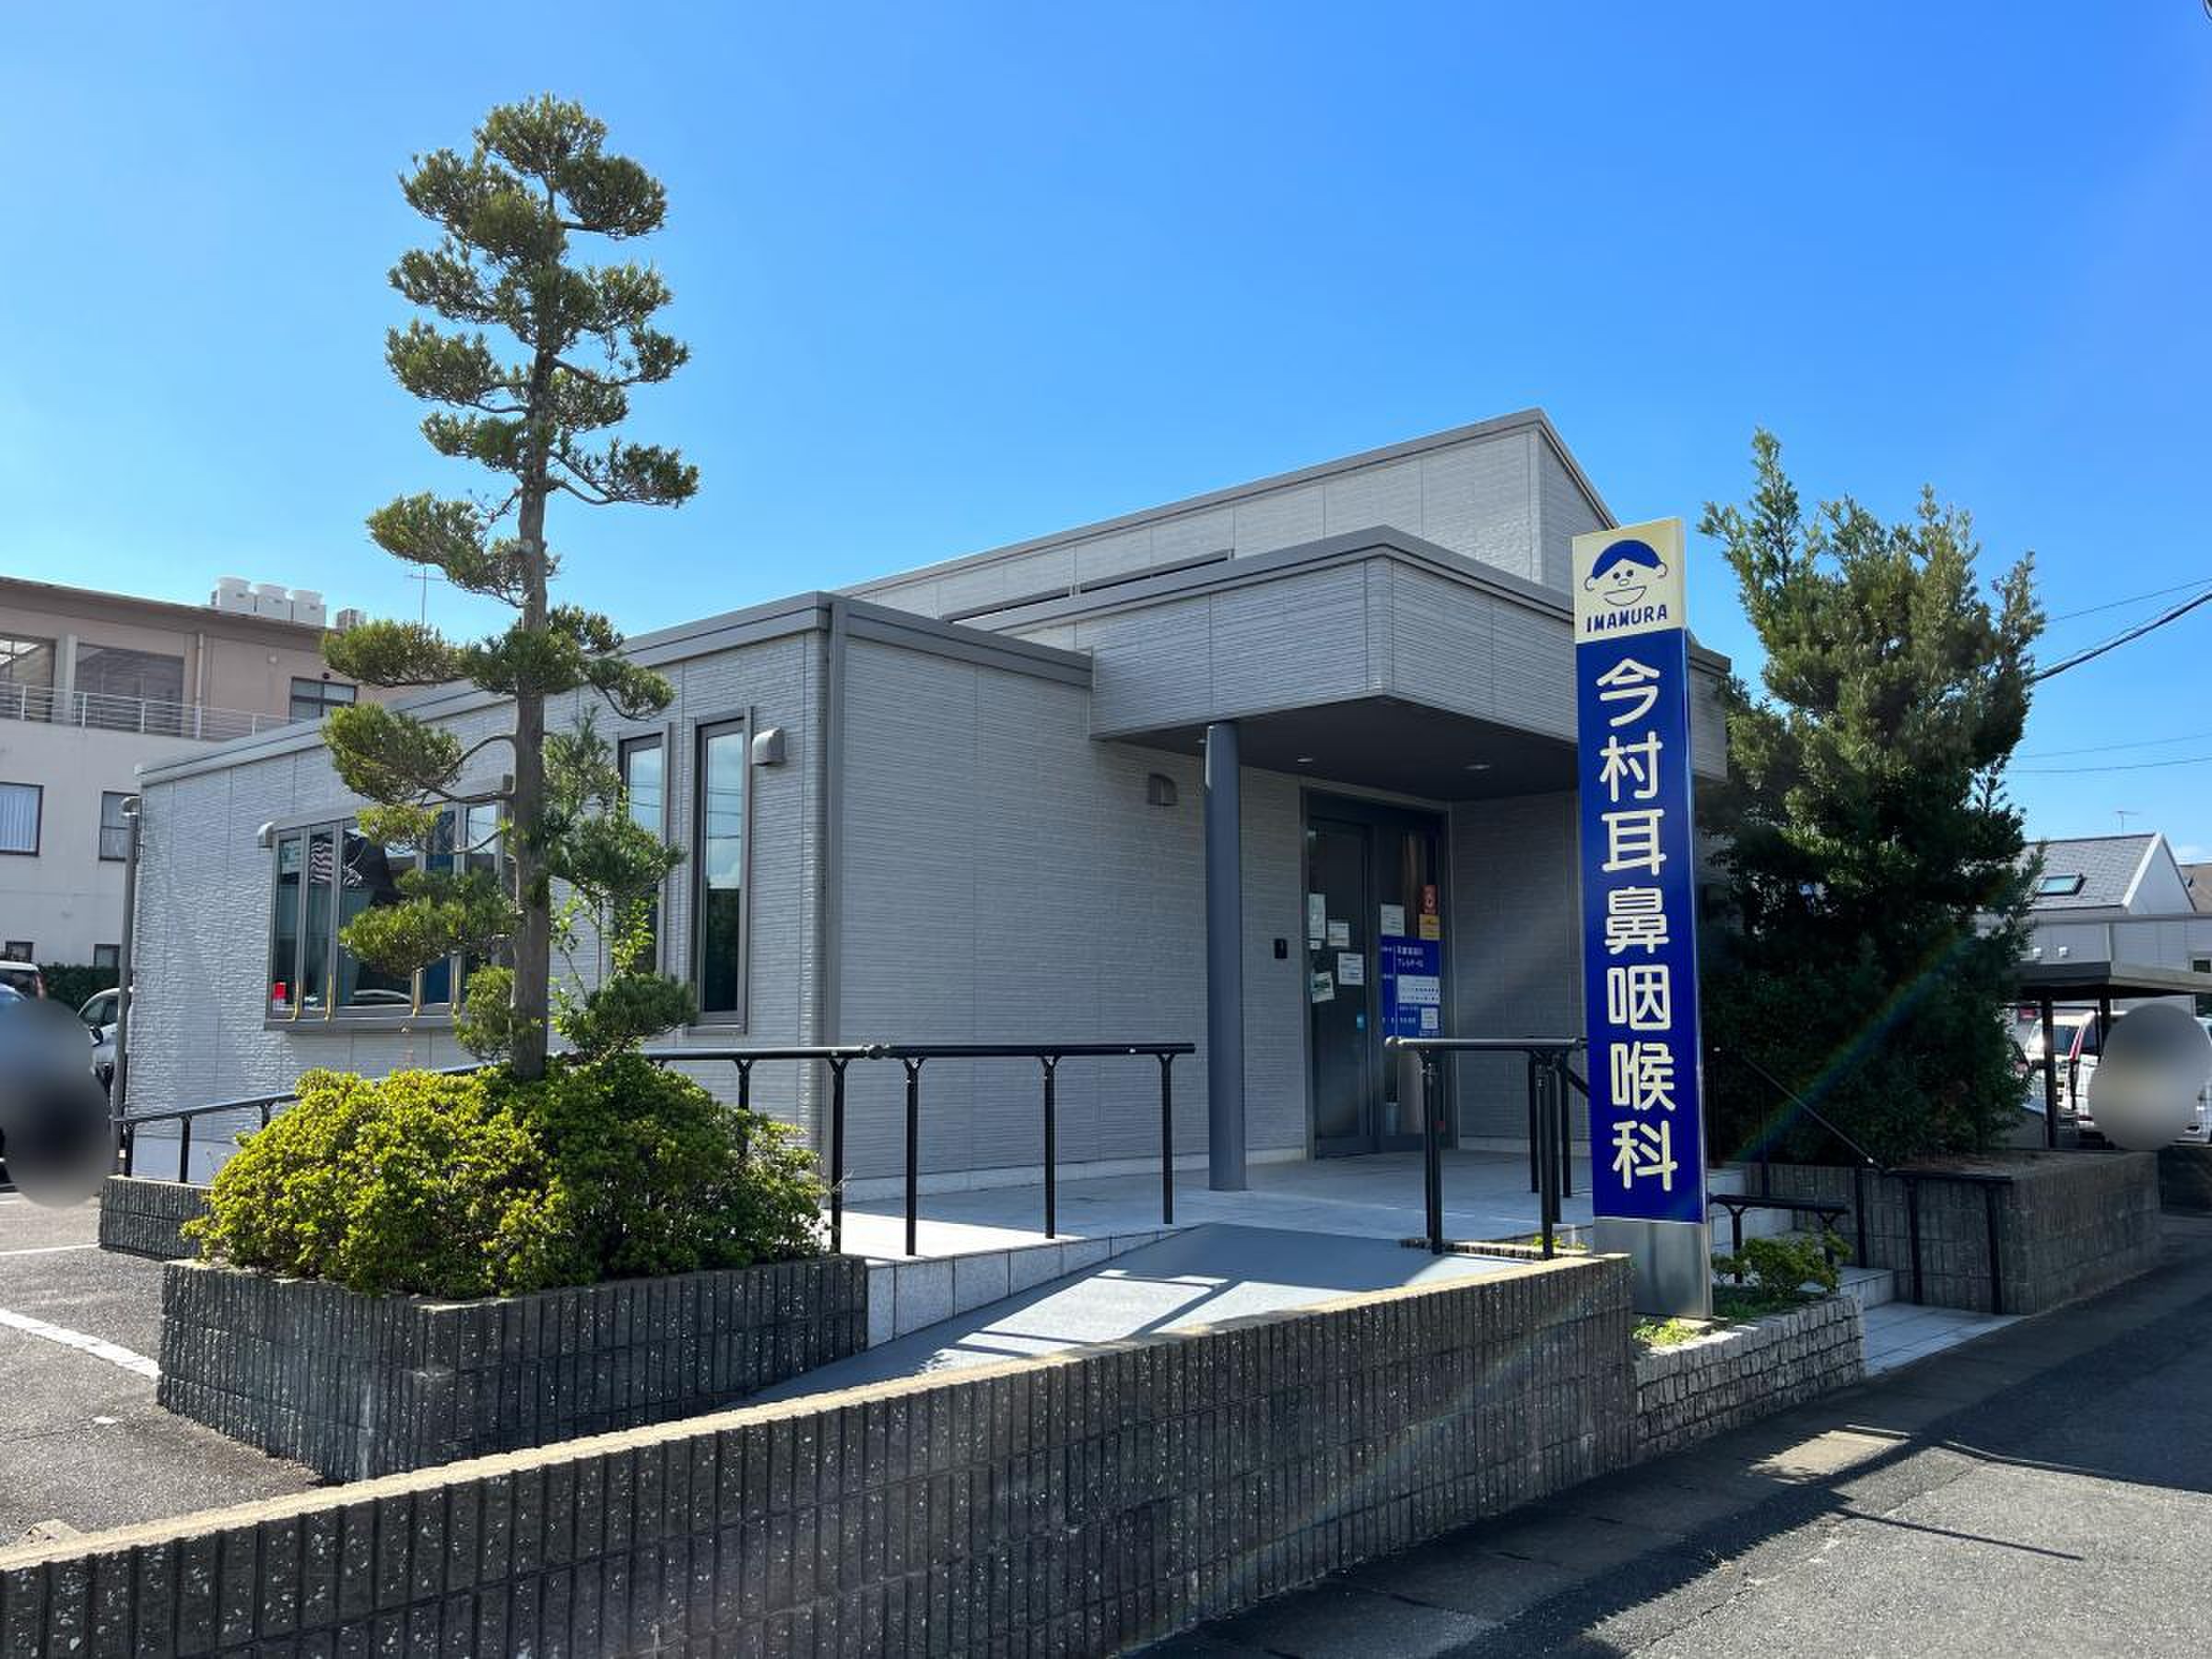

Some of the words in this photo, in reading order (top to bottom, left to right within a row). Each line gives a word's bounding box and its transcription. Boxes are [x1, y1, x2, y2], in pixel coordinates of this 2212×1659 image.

[1586, 605, 1667, 633] IMAMURA
[1596, 657, 1678, 1192] 今村耳鼻咽喉科
